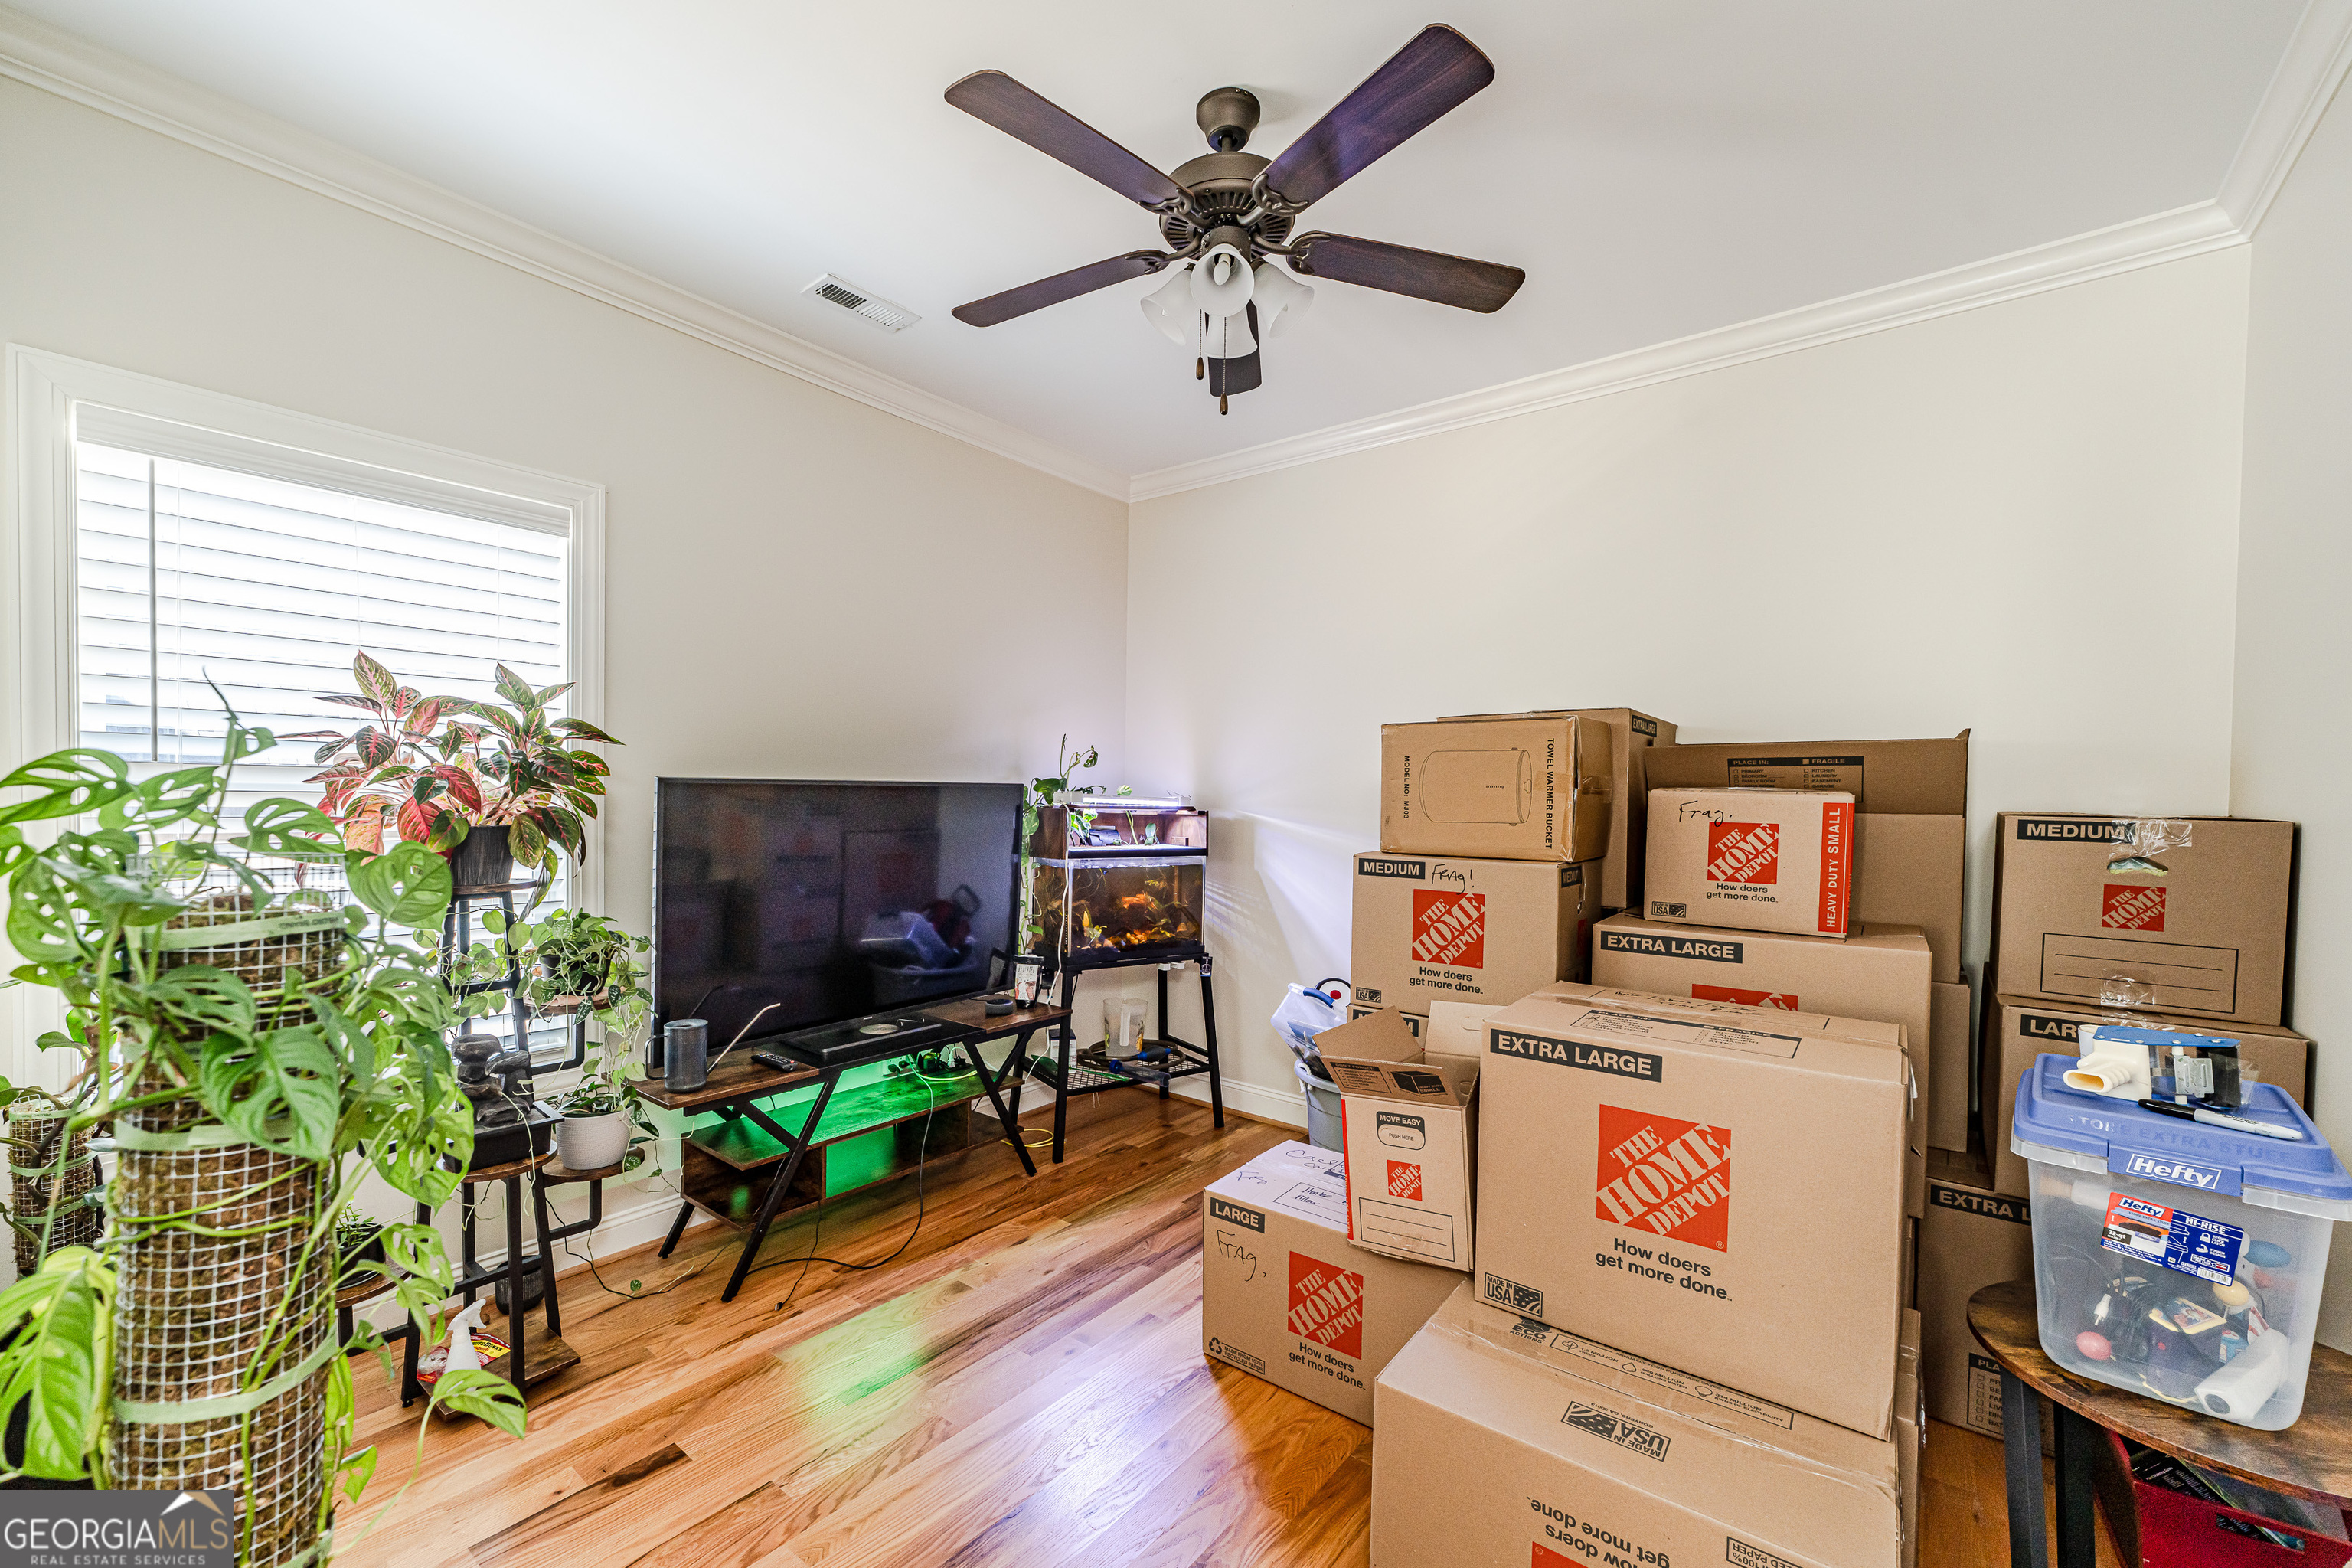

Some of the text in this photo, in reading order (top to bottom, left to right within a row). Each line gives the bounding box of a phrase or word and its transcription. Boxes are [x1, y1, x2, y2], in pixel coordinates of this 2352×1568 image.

[1546, 771, 1554, 811] WARMER
[1545, 813, 1553, 849] BUCKET
[1715, 828, 1744, 852] THE
[2026, 822, 2125, 839] MEDIUM
[1707, 823, 1779, 881] HOME
[1364, 861, 1419, 876] MEDIUM
[1734, 846, 1778, 883] DEPOT
[1826, 808, 1841, 927] HEAVY DUTY SMALL
[2102, 887, 2167, 929] HOME
[2109, 890, 2135, 906] THE
[1419, 898, 1449, 926] THE
[1653, 906, 1668, 915] USA
[2126, 903, 2165, 929] DEPOT
[1412, 893, 1485, 962] HOME
[1439, 921, 1485, 965] DEPOT
[1607, 935, 1735, 959] EXTRA LARGE
[1409, 976, 1425, 987] get
[1427, 979, 1453, 990] more
[1419, 966, 1472, 982] How doers
[1357, 991, 1368, 1000] USA
[2030, 1019, 2077, 1038] LAR
[1498, 1035, 1652, 1076] EXTRA LARGE
[1379, 1114, 1421, 1126] MOVE EASY
[1609, 1125, 1664, 1168] THE
[2139, 1129, 2213, 1149] EXTRA
[2220, 1142, 2293, 1161] STUFF
[1388, 1164, 1421, 1197] HOME
[1391, 1165, 1404, 1179] THE
[1596, 1123, 1731, 1226] HOME
[2133, 1158, 2214, 1187] Hefty
[1401, 1178, 1422, 1198] DEPOT
[1214, 1202, 1259, 1228] LARGE
[1645, 1172, 1730, 1236] DEPOT
[1939, 1190, 2014, 1217] EXTRA
[2122, 1199, 2162, 1217] Hefty
[2108, 1230, 2127, 1240] 32-qt
[1596, 1253, 1623, 1270] get
[1628, 1262, 1674, 1284] more
[1614, 1237, 1712, 1276] How doers
[1295, 1269, 1326, 1297] THE
[1487, 1276, 1513, 1291] MADE IN
[1487, 1285, 1512, 1305] USA
[1288, 1270, 1364, 1337] HOME
[1315, 1305, 1362, 1346] DEPOT
[1509, 1330, 1543, 1344] ACTIONS
[1511, 1325, 1547, 1340] ECO
[1225, 1346, 1237, 1354] MADE
[1238, 1352, 1250, 1361] FROM
[1225, 1351, 1263, 1372] RECYCLED PAPER
[1289, 1351, 1305, 1365] get
[1308, 1359, 1334, 1377] more
[1299, 1342, 1354, 1373] How doers
[1590, 1351, 1619, 1363] MILLION
[1615, 1352, 1646, 1364] ANNUALLY
[1646, 1363, 1665, 1371] YOUR
[1978, 1359, 2001, 1372] PLA
[1640, 1371, 1687, 1390] GALLONS WATER
[1655, 1372, 1685, 1385] MILLION
[1730, 1398, 1762, 1411] MILLION
[1743, 1406, 1784, 1422] ELECTRICITY
[1613, 1434, 1661, 1458] MADE IN
[1621, 1422, 1665, 1451] USA
[1545, 1524, 1637, 1568] ow doers
[1581, 1522, 1632, 1553] more
[1636, 1546, 1670, 1568] get
[1733, 1542, 1768, 1564] PAPER
[1733, 1552, 1760, 1568] 100%
